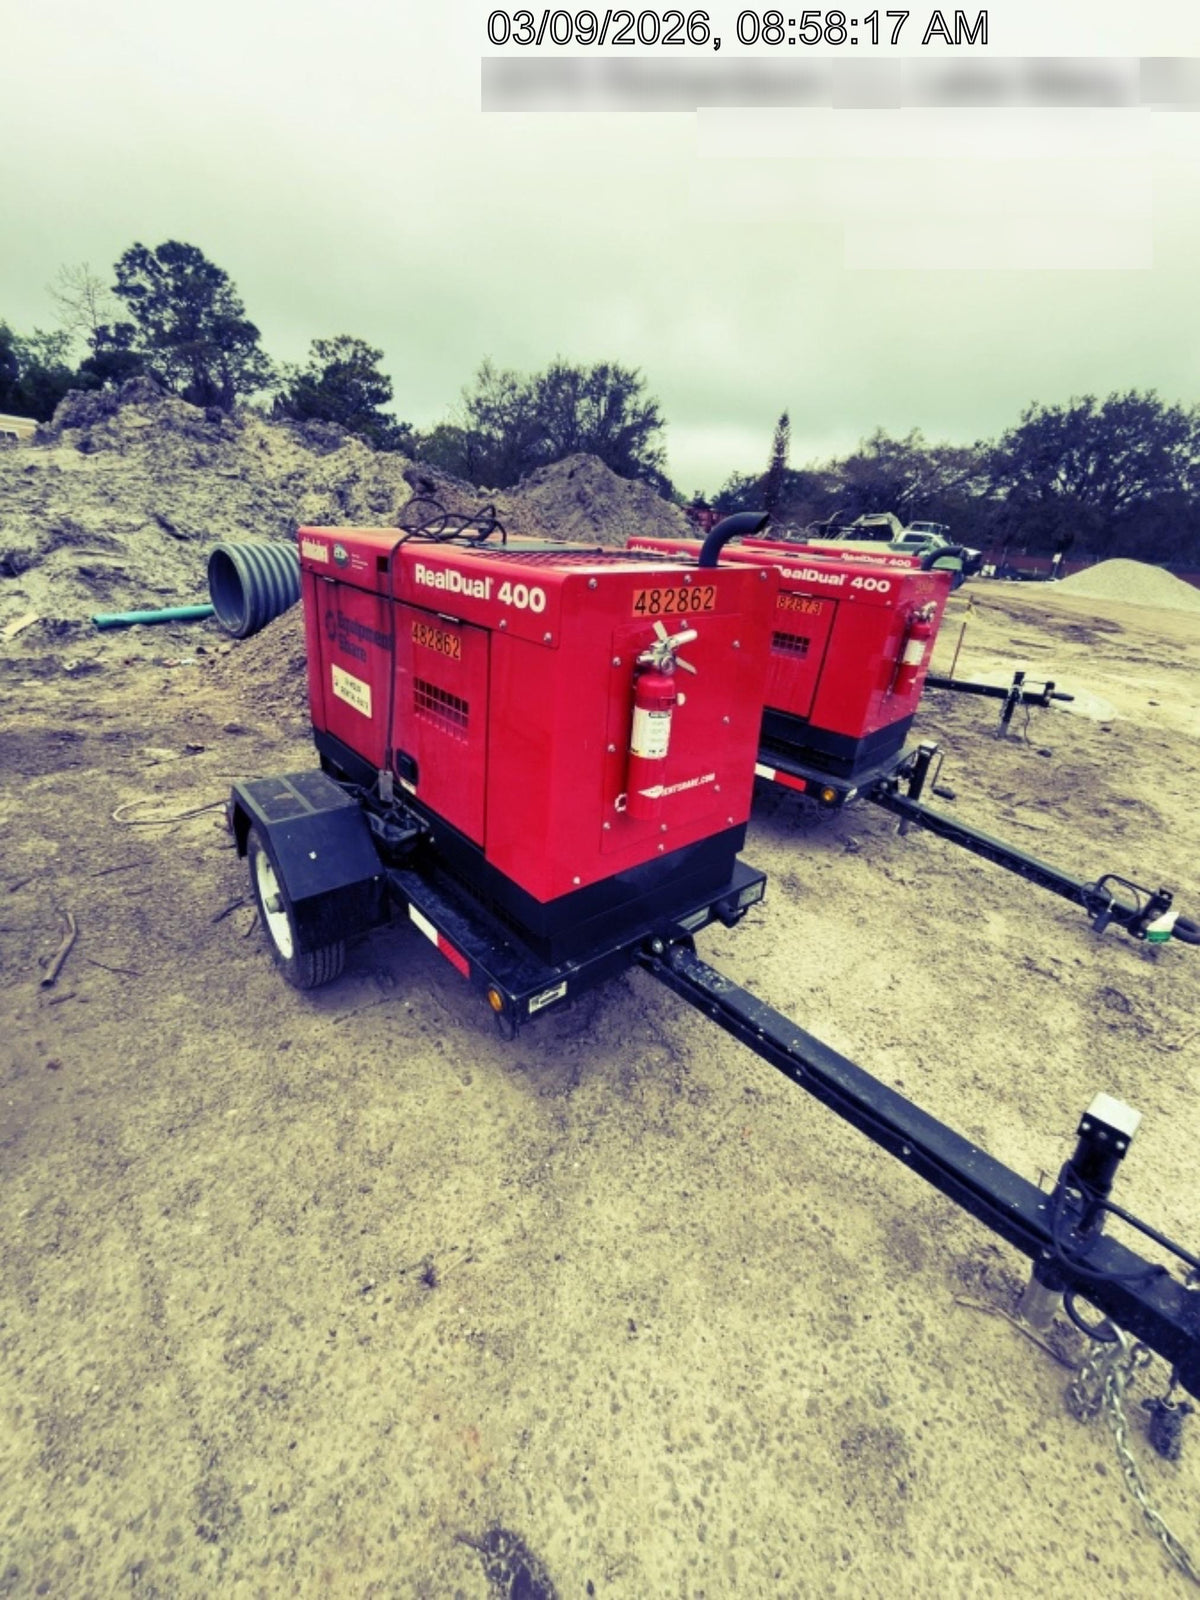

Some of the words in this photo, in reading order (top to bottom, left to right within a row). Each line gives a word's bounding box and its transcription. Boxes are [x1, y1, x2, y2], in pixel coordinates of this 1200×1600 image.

[888, 558, 912, 568] 400
[414, 562, 491, 600] RealDual
[497, 581, 547, 613] 400
[850, 576, 892, 593] 400
[634, 586, 715, 615] 482862
[412, 622, 461, 660] 482862
